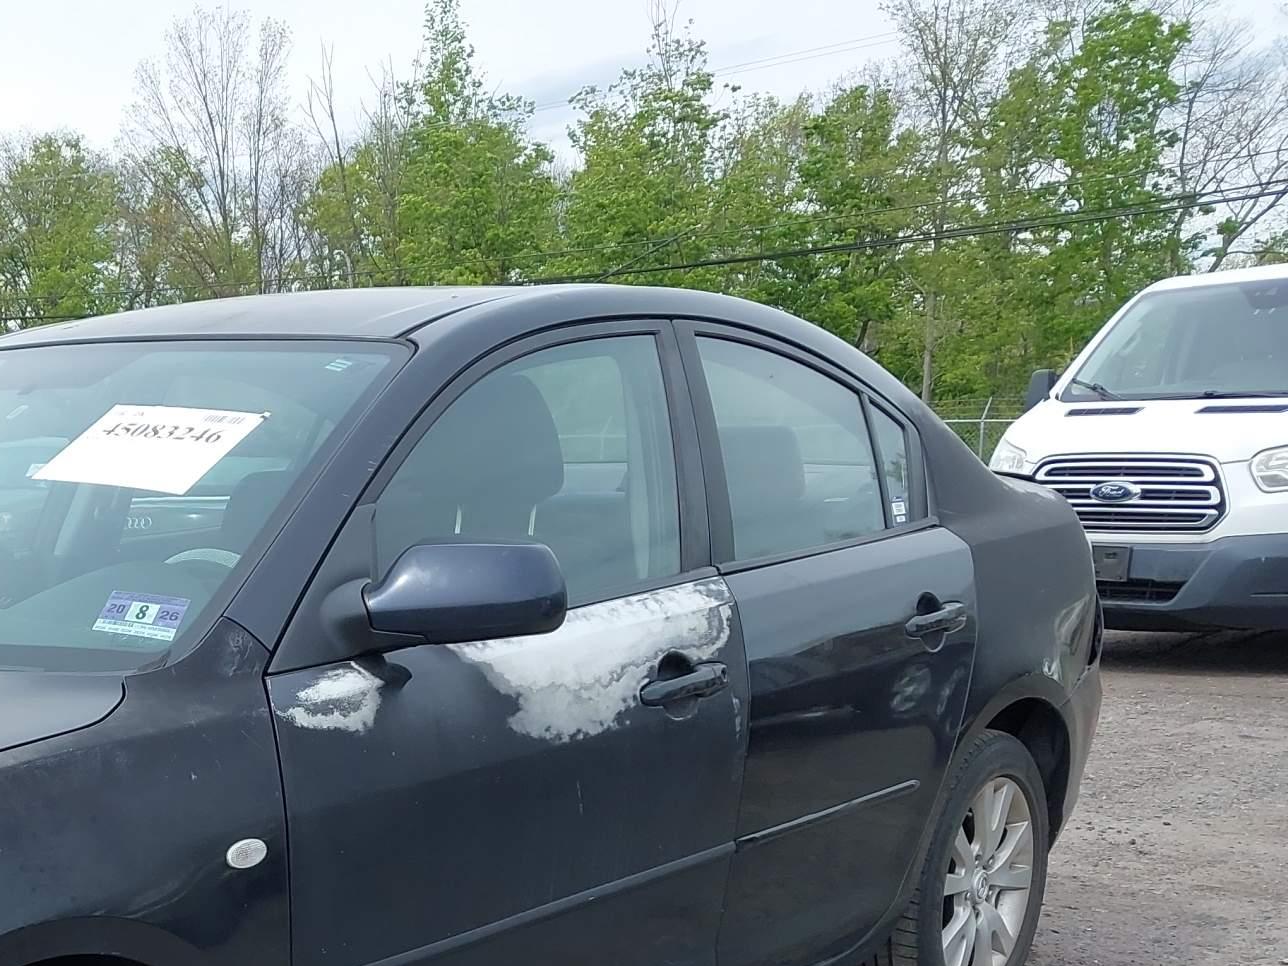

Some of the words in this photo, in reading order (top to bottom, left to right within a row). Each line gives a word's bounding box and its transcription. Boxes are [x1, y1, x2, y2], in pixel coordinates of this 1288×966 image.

[102, 423, 224, 443] 45083246
[1098, 485, 1125, 497] Ford
[107, 603, 126, 614] 20
[135, 604, 150, 620] 8
[158, 610, 180, 621] 26
